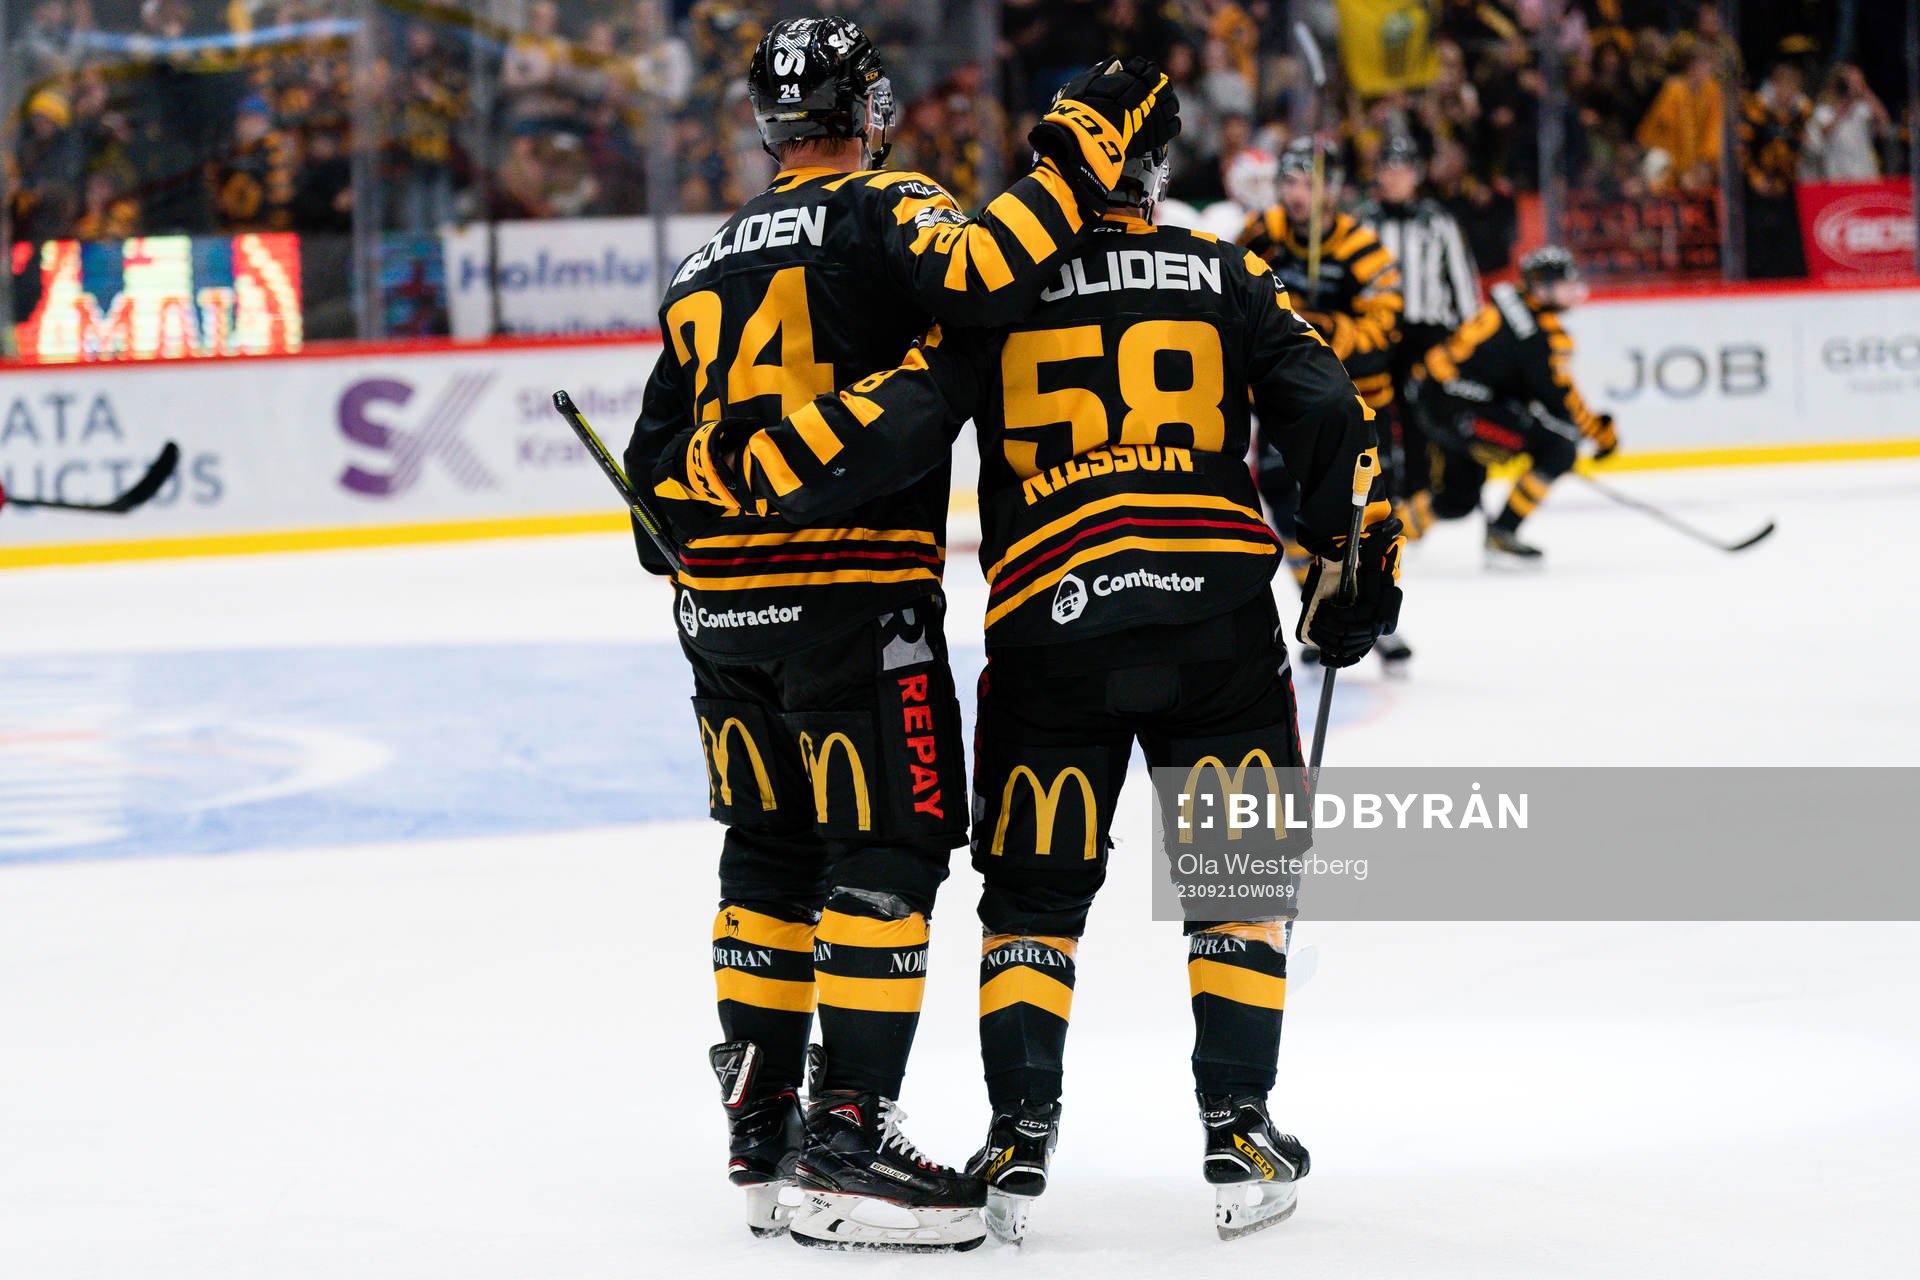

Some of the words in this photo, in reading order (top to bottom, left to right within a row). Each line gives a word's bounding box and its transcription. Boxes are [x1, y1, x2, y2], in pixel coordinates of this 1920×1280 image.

[780, 84, 800, 99] 24
[1053, 103, 1123, 165] CCM
[1604, 343, 1769, 400] JOB
[1001, 319, 1225, 482] 58
[1021, 445, 1194, 507] NILSSON
[1093, 568, 1205, 597] Contractor
[698, 604, 803, 629] Contractor
[897, 673, 945, 820] REPAY
[987, 947, 1067, 970] NORRAN
[1019, 1119, 1049, 1130] CCM
[1202, 1110, 1232, 1119] CCM
[872, 1163, 910, 1181] BAUER
[1240, 1142, 1273, 1176] CCM
